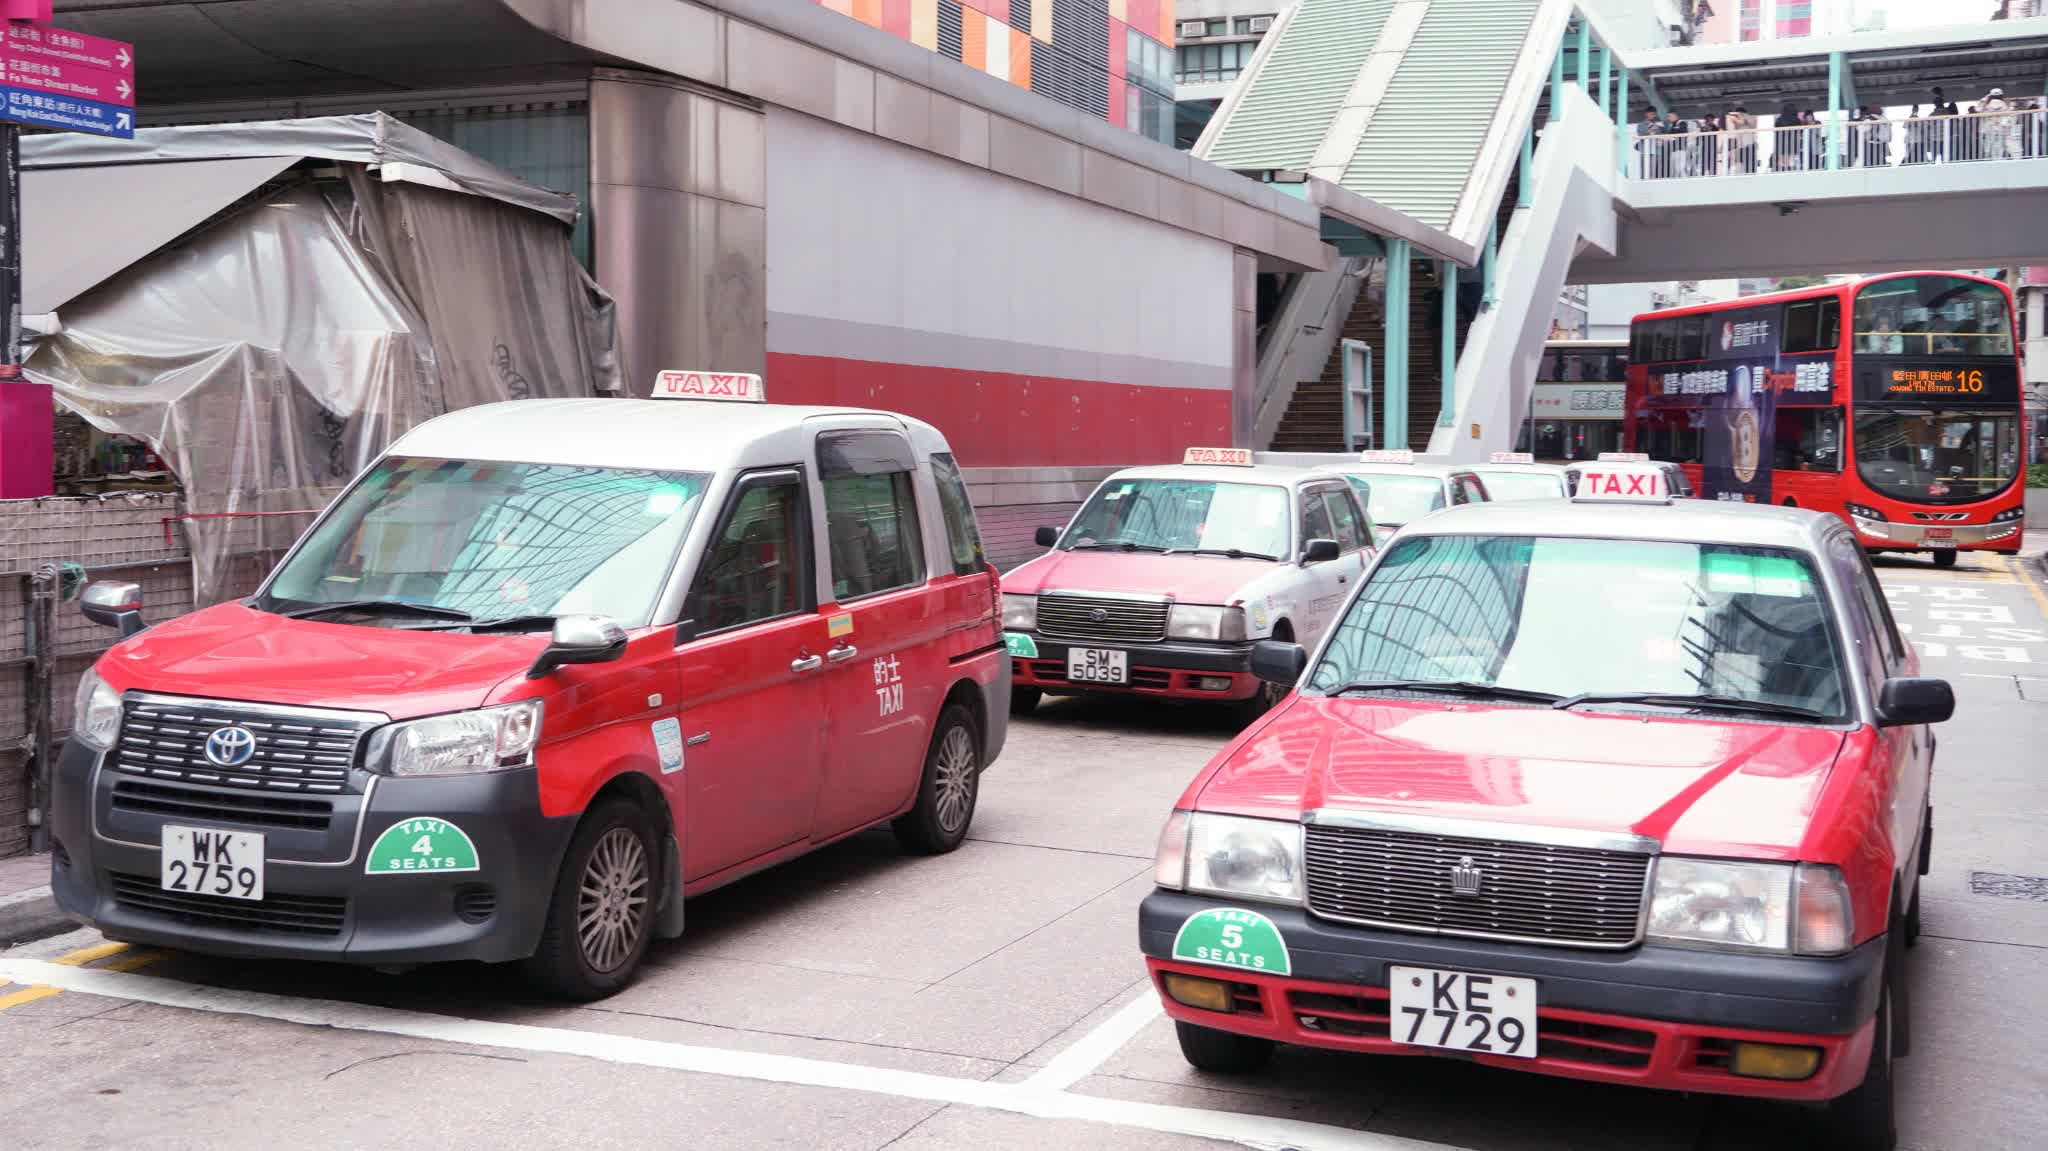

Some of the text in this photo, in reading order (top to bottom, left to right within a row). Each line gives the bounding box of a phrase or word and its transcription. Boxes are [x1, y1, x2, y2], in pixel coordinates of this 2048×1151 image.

[662, 372, 749, 397] TAXI
[1956, 370, 1983, 393] 16
[1188, 449, 1249, 465] TAXI
[1586, 473, 1657, 495] TAXI
[1086, 650, 1110, 666] SM
[873, 653, 901, 687] 的士
[1072, 664, 1122, 683] 5039
[876, 685, 904, 716] TAXI
[400, 818, 446, 836] TAXI
[192, 831, 234, 863] WK
[411, 834, 433, 857] 4
[389, 856, 457, 870] SEATS
[168, 860, 257, 898] 2759
[1214, 909, 1258, 927] TAXI
[1221, 924, 1243, 949] 5
[1196, 946, 1267, 968] SEATS
[1431, 972, 1495, 1016] KE
[1400, 1006, 1526, 1055] 7729
